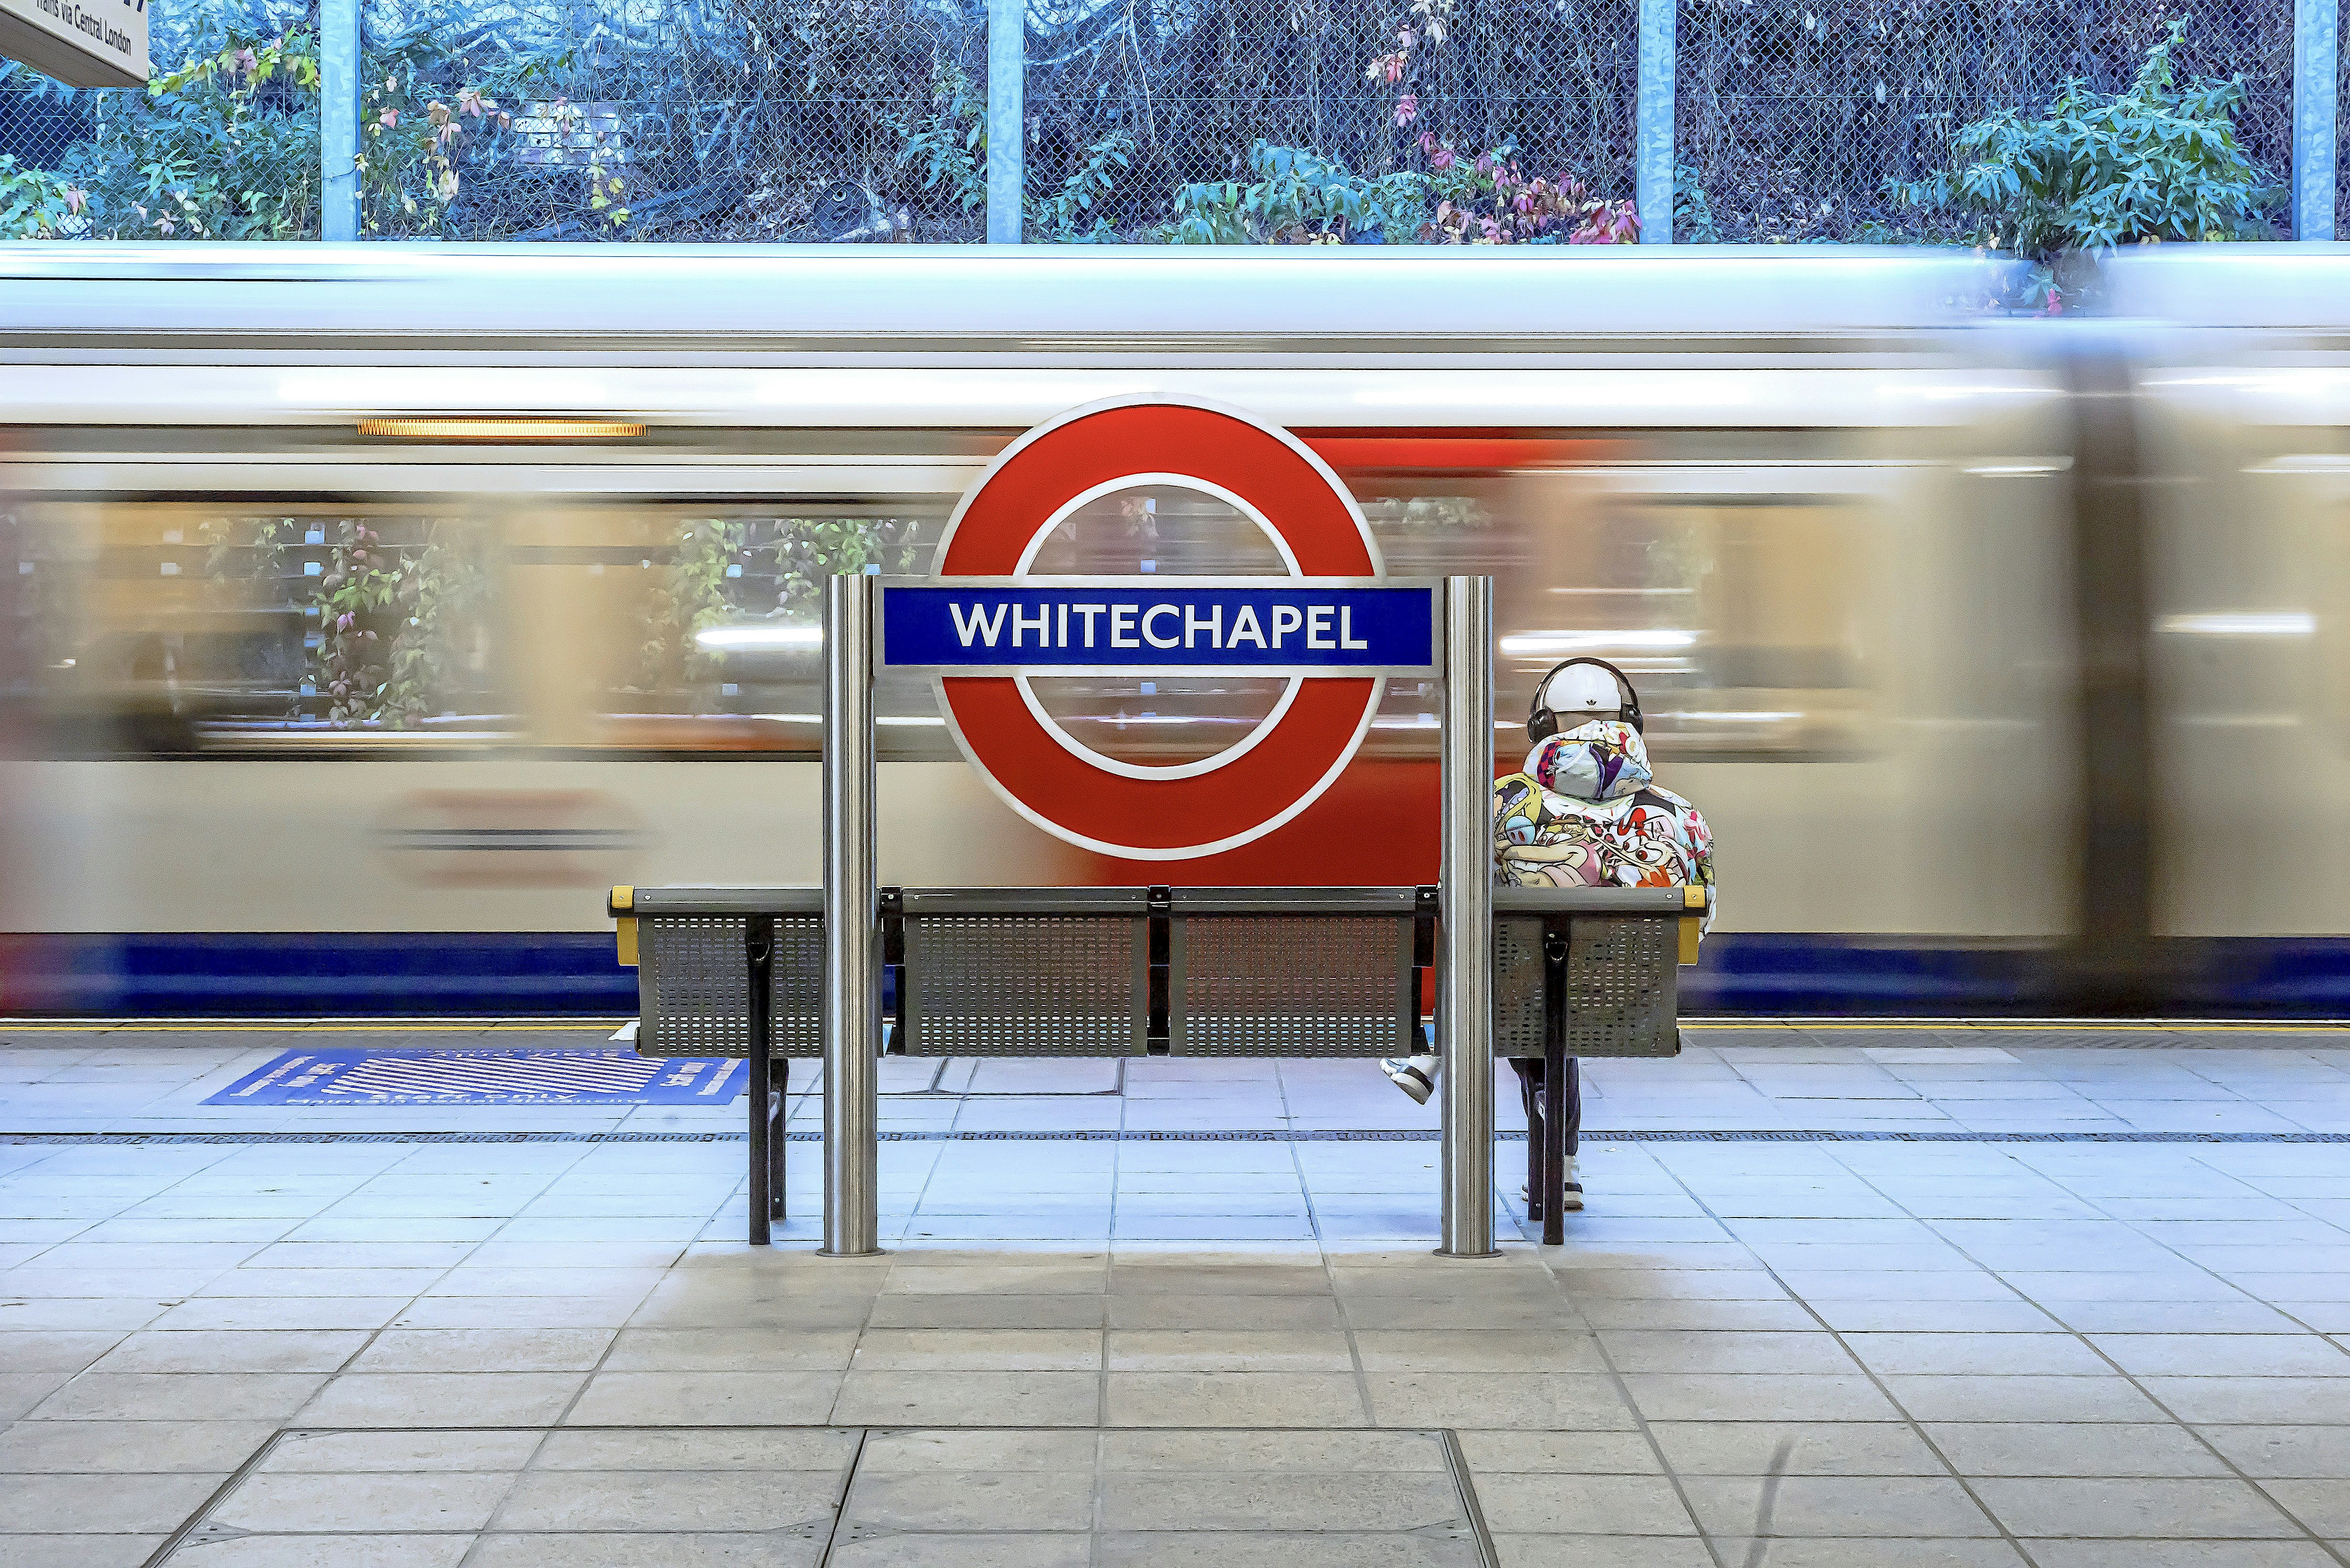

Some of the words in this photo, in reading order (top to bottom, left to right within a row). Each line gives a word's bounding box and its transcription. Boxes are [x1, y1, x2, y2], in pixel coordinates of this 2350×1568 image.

[61, 0, 72, 25] via
[74, 4, 103, 41] Central
[105, 20, 131, 56] London
[949, 602, 1368, 650] WHITECHAPEL
